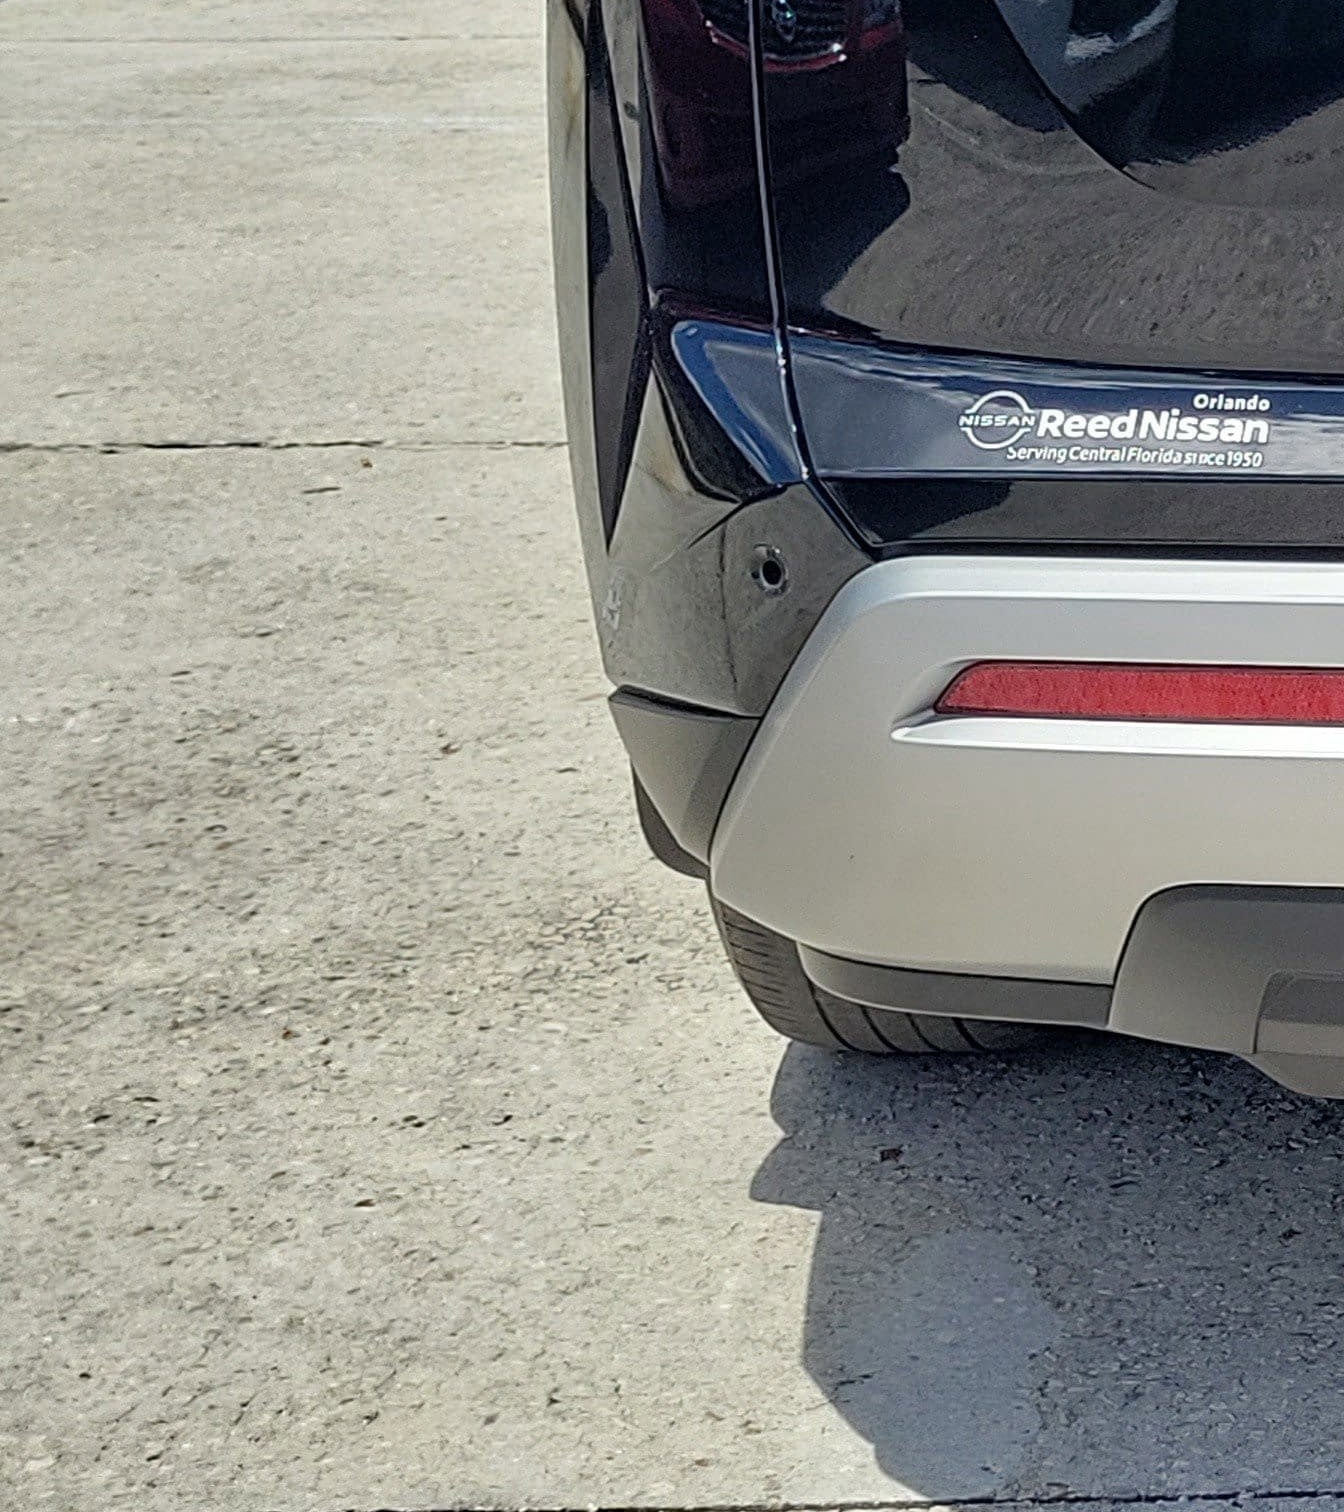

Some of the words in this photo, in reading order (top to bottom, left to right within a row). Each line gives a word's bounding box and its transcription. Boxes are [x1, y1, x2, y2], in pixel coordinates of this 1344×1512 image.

[1192, 393, 1271, 411] Orlando
[958, 414, 1036, 428] NISSAN
[1006, 445, 1067, 464] Serving
[1068, 445, 1127, 462] Central
[1126, 446, 1182, 464] Florida
[1226, 450, 1263, 468] 1950
